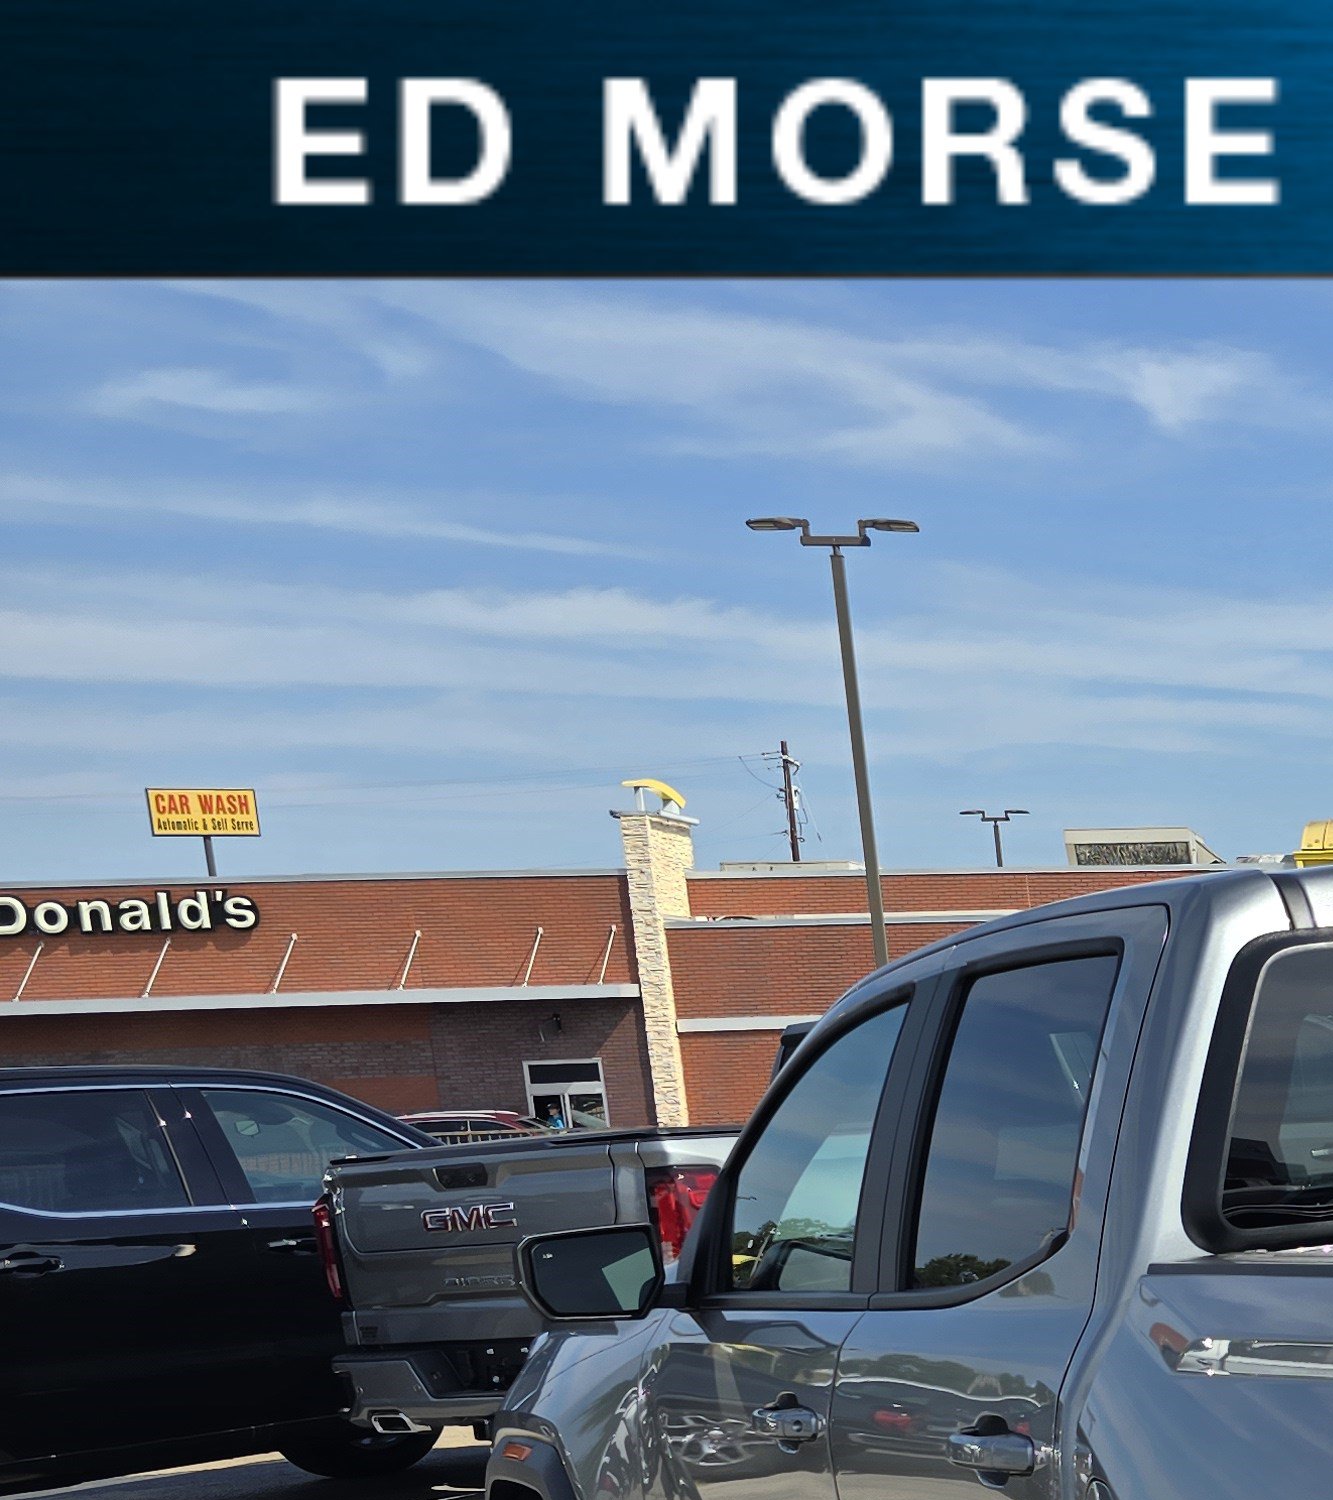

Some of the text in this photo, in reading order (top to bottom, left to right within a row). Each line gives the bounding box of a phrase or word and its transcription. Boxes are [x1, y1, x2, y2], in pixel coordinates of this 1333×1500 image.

[154, 793, 251, 815] CAR WASH
[157, 818, 199, 831] Automatic
[212, 819, 228, 831] Self
[231, 819, 255, 831] Serve
[420, 1202, 518, 1233] GMC
